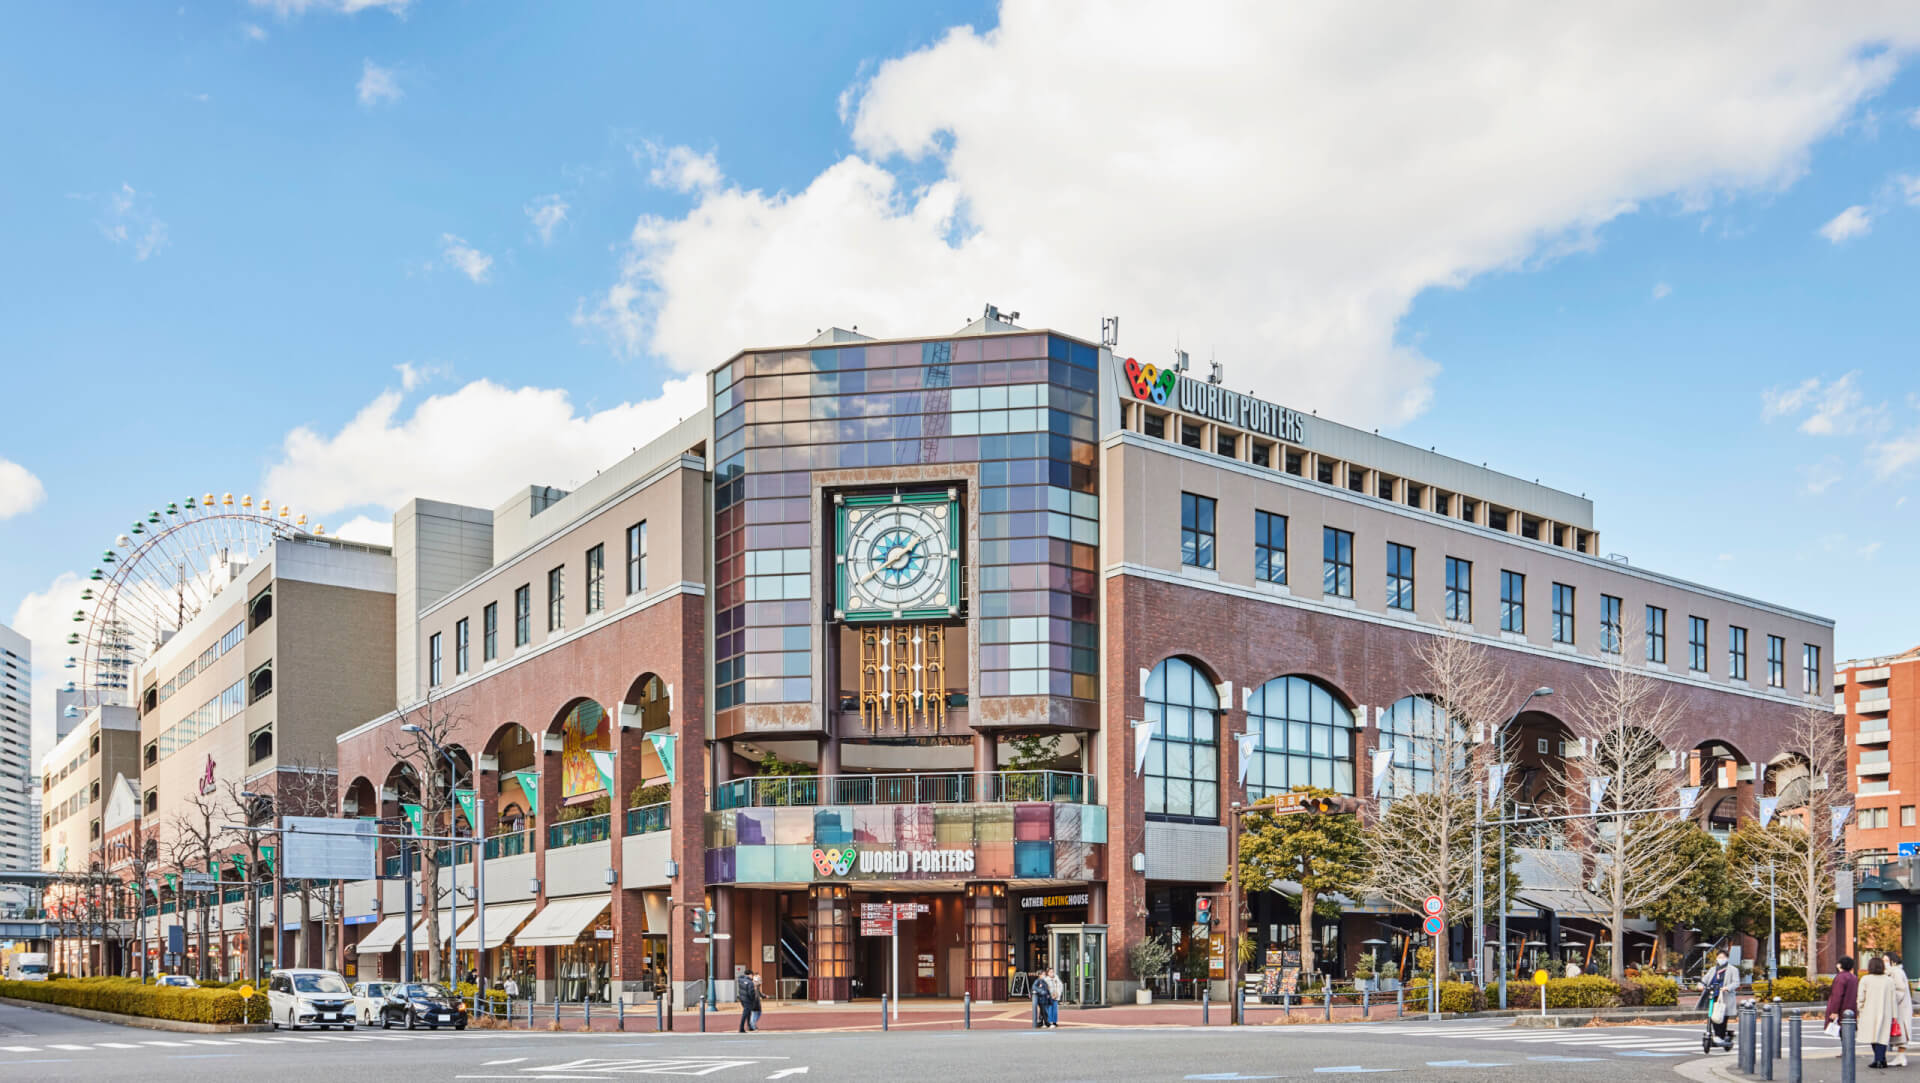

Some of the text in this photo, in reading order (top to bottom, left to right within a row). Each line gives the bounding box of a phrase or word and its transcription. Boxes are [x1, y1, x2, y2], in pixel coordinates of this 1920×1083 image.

[1180, 376, 1305, 443] WORLD PORTERS
[860, 849, 975, 873] WORLD PORTERS
[1428, 901, 1439, 910] 40
